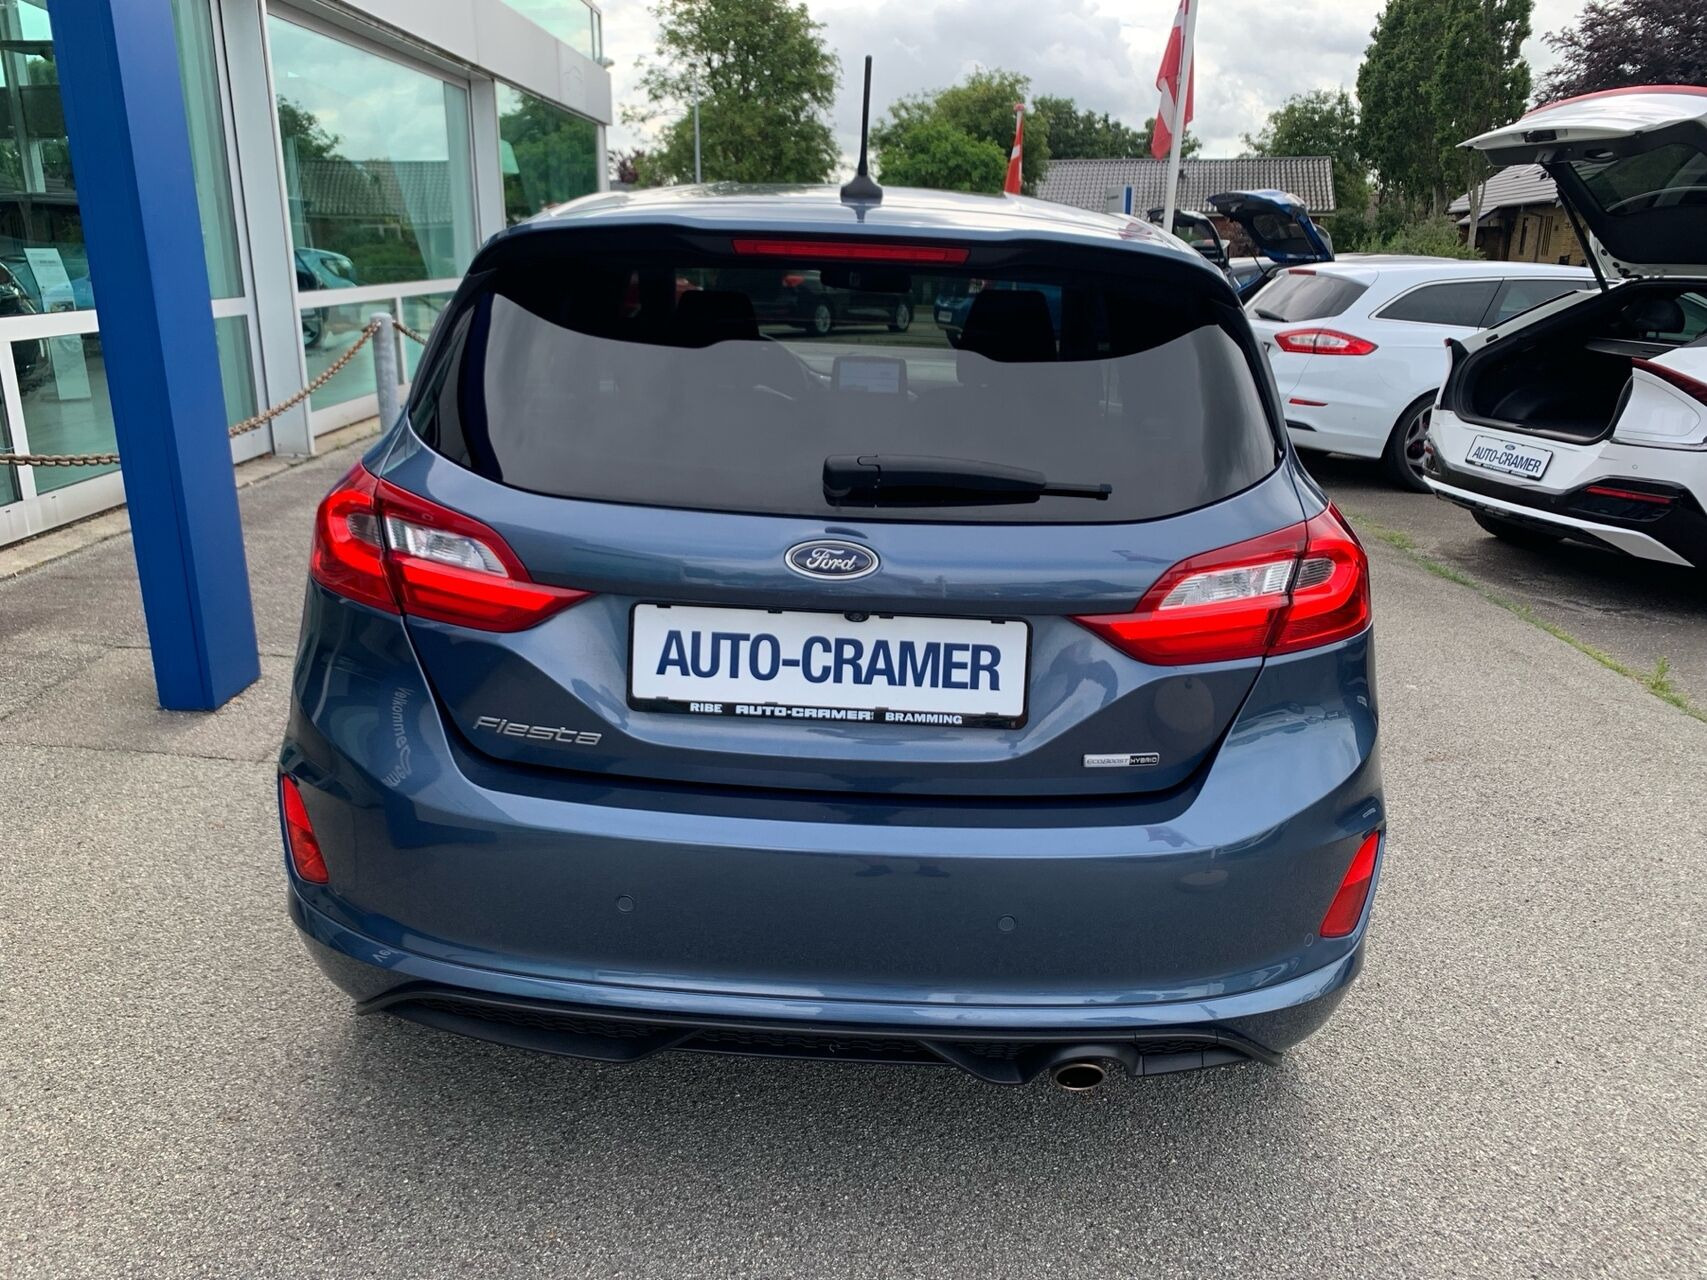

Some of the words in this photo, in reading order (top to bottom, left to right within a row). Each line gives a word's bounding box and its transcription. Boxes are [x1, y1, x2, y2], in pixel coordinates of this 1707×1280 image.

[1472, 446, 1542, 474] AUTO-CRAMER
[806, 547, 857, 570] Ford
[655, 629, 1002, 692] AUTO-CRAMER
[689, 702, 723, 714] RIBE
[885, 711, 963, 725] BRAMMING
